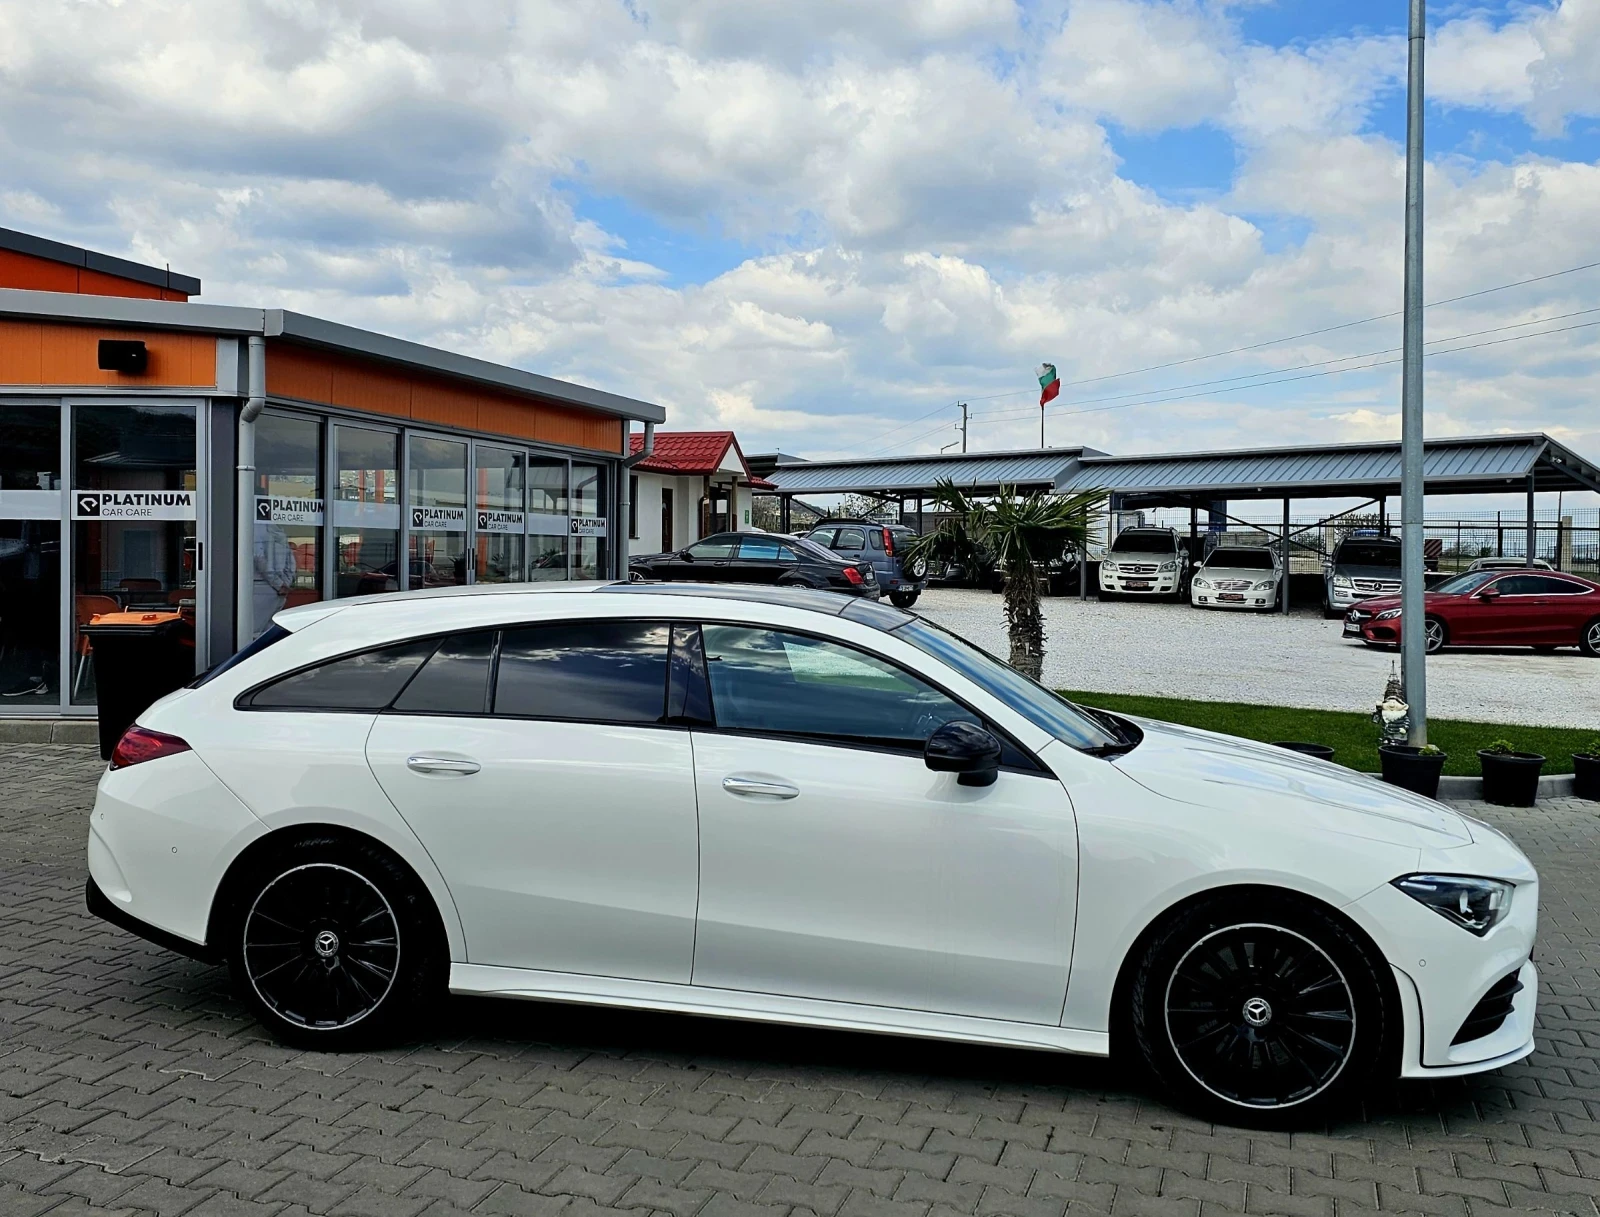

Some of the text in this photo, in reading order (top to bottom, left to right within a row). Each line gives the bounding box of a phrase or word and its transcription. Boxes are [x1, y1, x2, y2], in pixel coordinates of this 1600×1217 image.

[102, 493, 191, 506] PLATINUM
[273, 499, 324, 513] PLATINUM
[102, 508, 152, 517] CAR CARE
[272, 513, 304, 522] CAR CARE
[424, 508, 464, 520] PLATINUM
[488, 512, 523, 524] PLATINUM
[579, 519, 605, 528] PLATINUM
